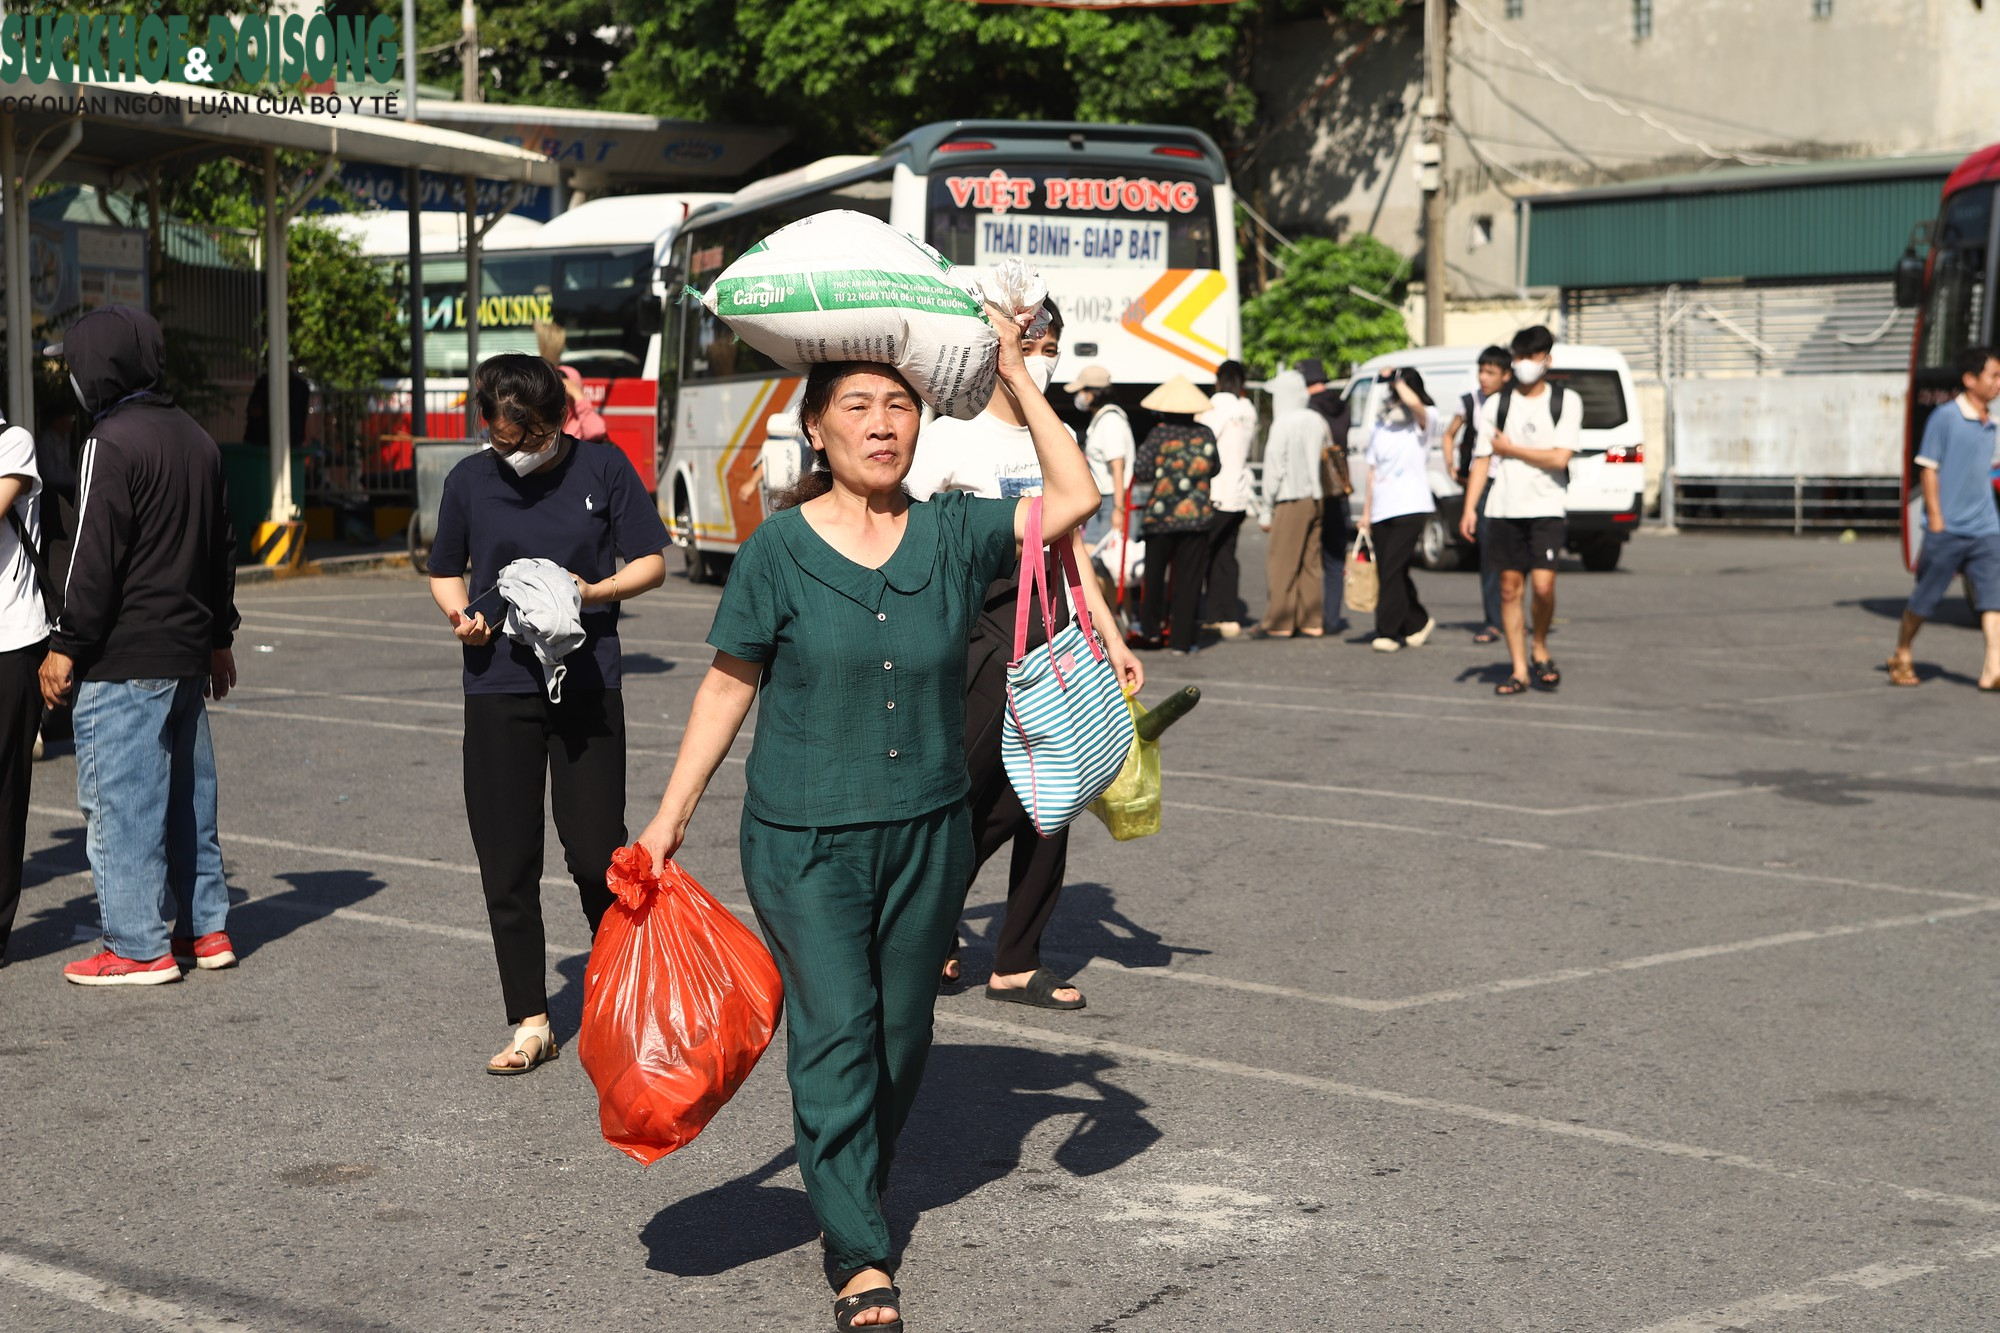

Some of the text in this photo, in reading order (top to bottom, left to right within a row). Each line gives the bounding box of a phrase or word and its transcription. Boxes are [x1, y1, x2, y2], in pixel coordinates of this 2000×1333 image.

[946, 169, 1199, 215] VIỆT PHƯƠNG
[983, 217, 1022, 255] THÁI
[1028, 217, 1070, 257] BÌNH
[1084, 222, 1123, 259] GIÁP
[1129, 223, 1162, 261] BÁT
[454, 293, 554, 328] LMOUSINE
[733, 284, 785, 308] Cargill
[847, 292, 857, 302] 22
